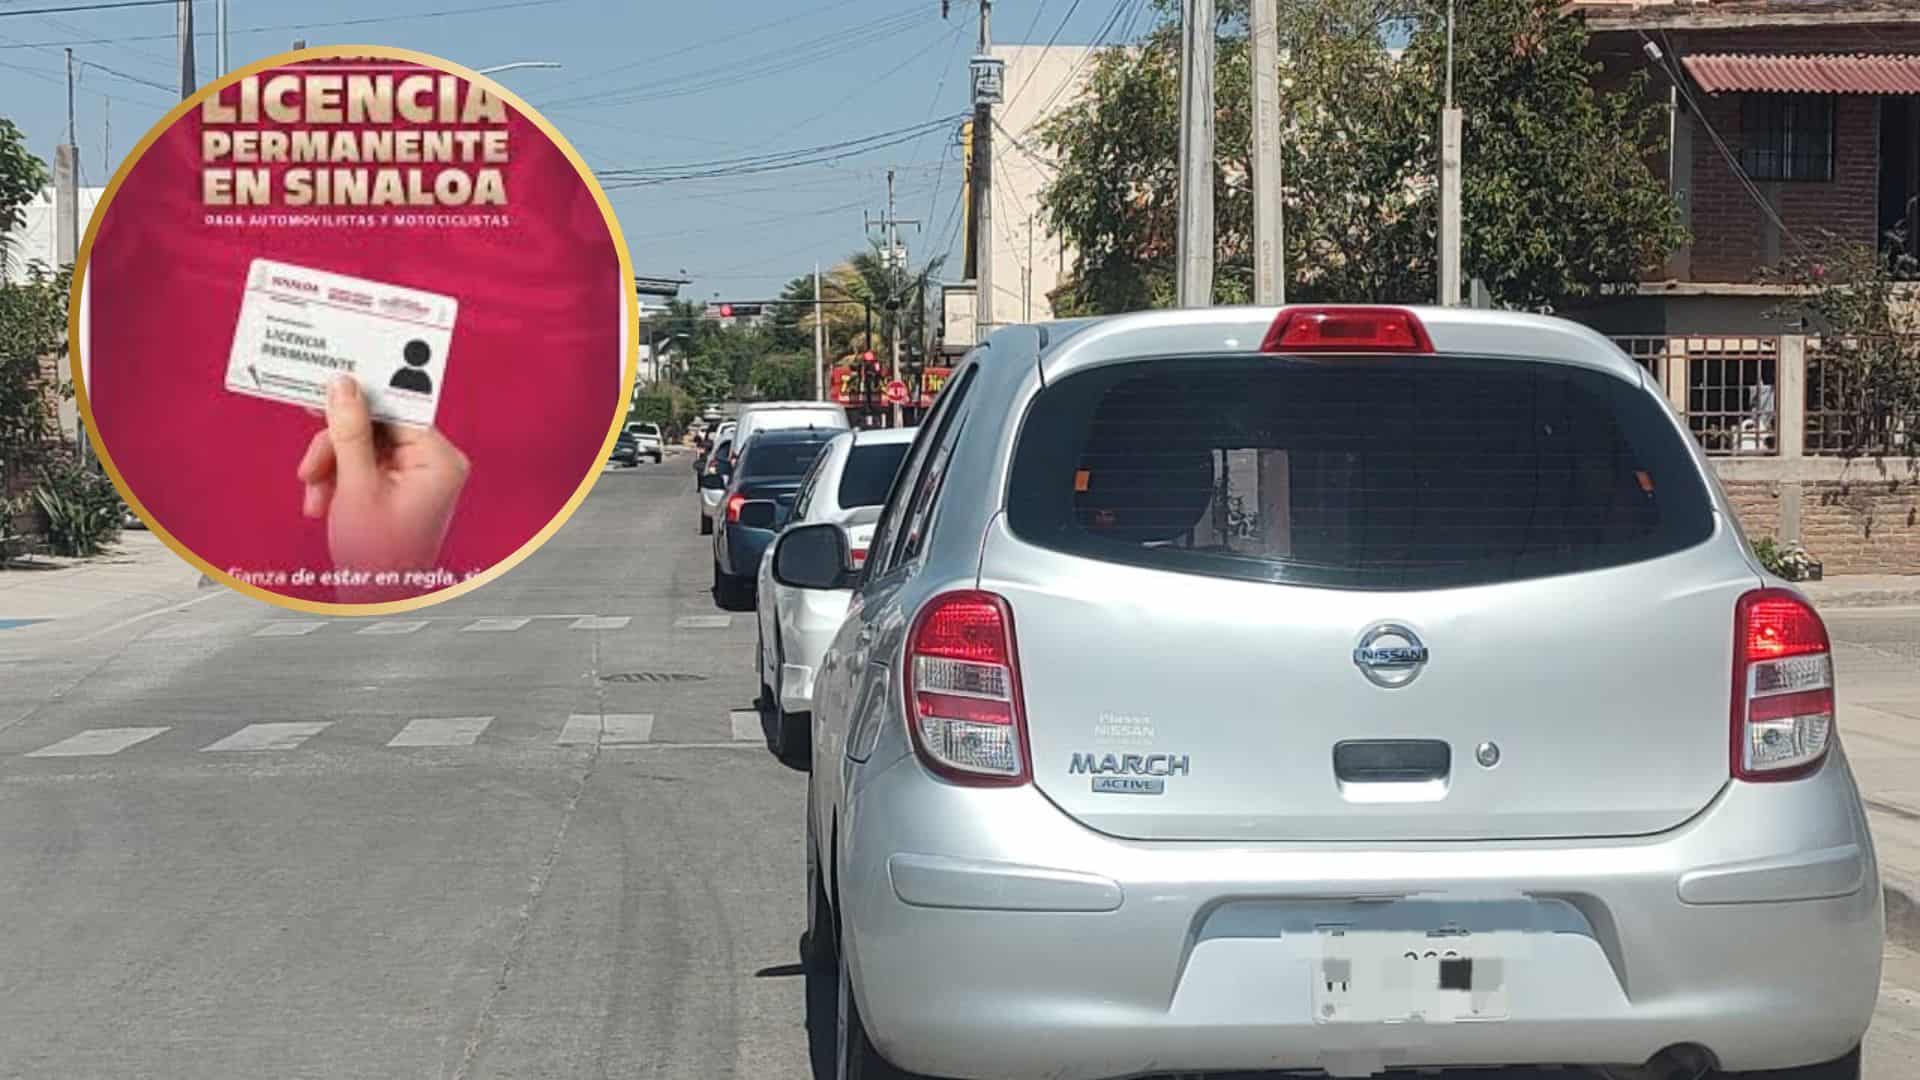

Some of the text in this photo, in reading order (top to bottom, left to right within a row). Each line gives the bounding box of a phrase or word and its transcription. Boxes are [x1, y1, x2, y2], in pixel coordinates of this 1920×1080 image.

[1361, 649, 1421, 660] NISSAN
[1095, 725, 1154, 737] NISSAN
[1069, 751, 1190, 777] MARCH
[1101, 779, 1153, 790] ACTIVE
